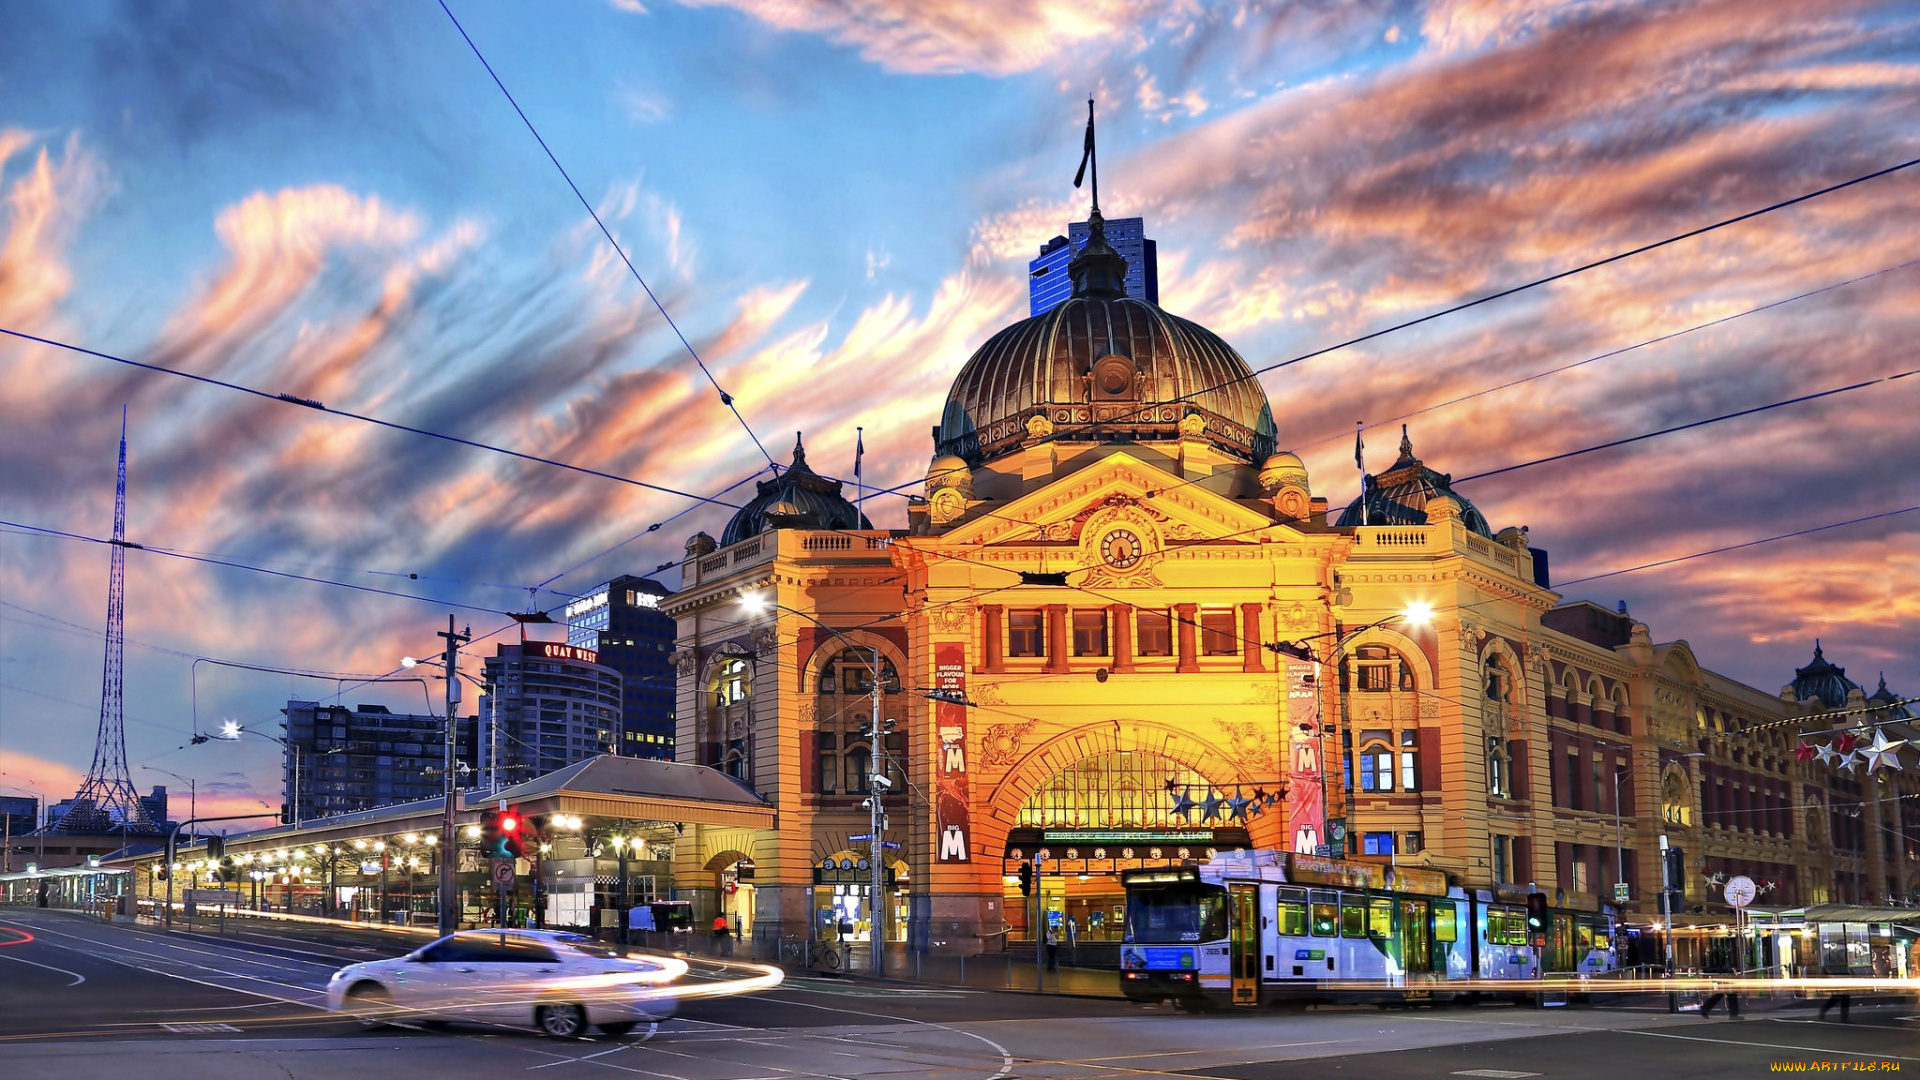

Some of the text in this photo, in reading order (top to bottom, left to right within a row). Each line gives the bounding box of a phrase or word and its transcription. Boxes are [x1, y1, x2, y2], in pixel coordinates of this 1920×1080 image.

[545, 644, 596, 663] QUAY WEST
[945, 748, 966, 773] M
[1297, 748, 1318, 773] M
[940, 830, 967, 861] M
[1295, 830, 1318, 856] M
